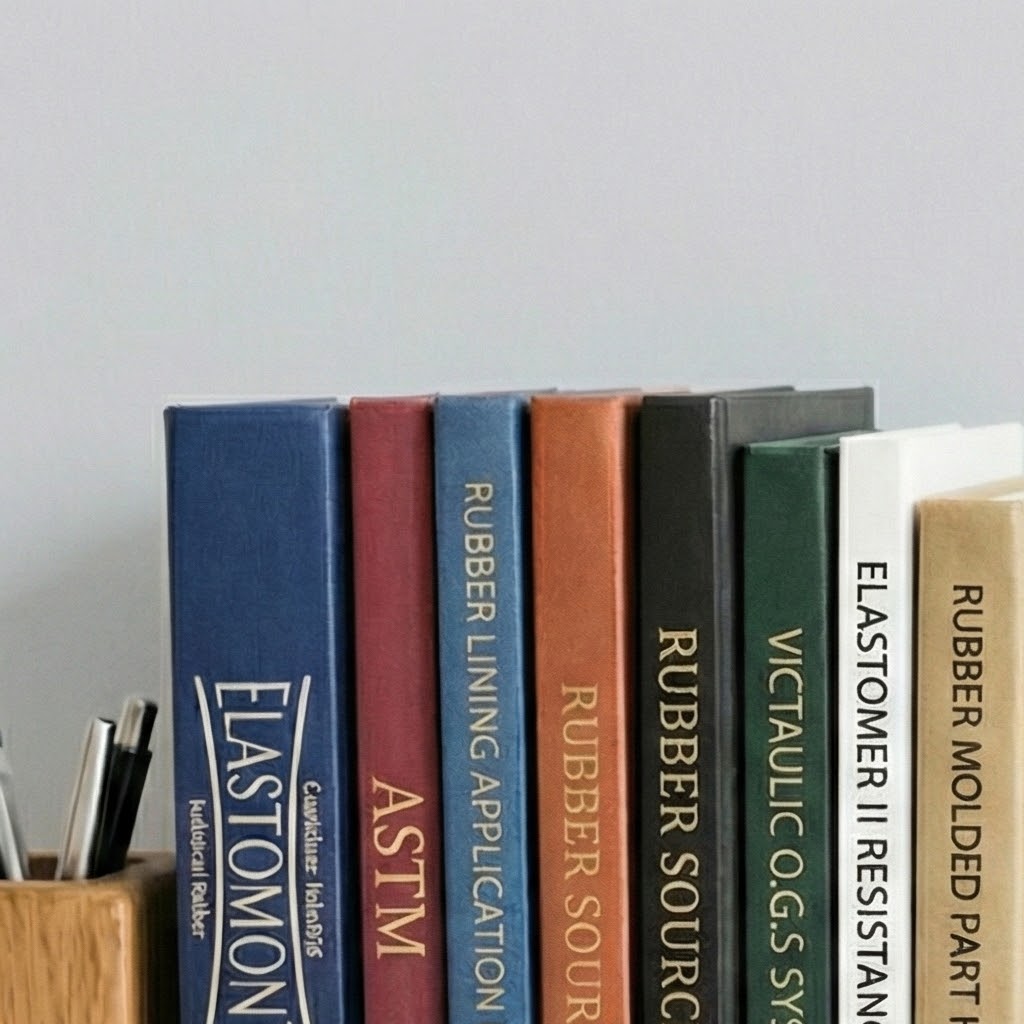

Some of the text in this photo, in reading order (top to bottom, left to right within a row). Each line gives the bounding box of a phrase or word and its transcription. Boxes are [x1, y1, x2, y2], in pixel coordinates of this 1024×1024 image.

[464, 482, 496, 622] RUBBER
[467, 635, 499, 761] LINING
[657, 627, 699, 838] RUBBER
[768, 628, 804, 837] VICTAULIC
[856, 561, 889, 789] ELASTOMER
[952, 584, 984, 727] RUBBER
[371, 776, 426, 960] ASTM
[561, 682, 601, 880] RUBBER
[950, 740, 983, 901] MOLDED
[470, 771, 505, 1011] APPLICATION
[949, 913, 981, 1005] PART
